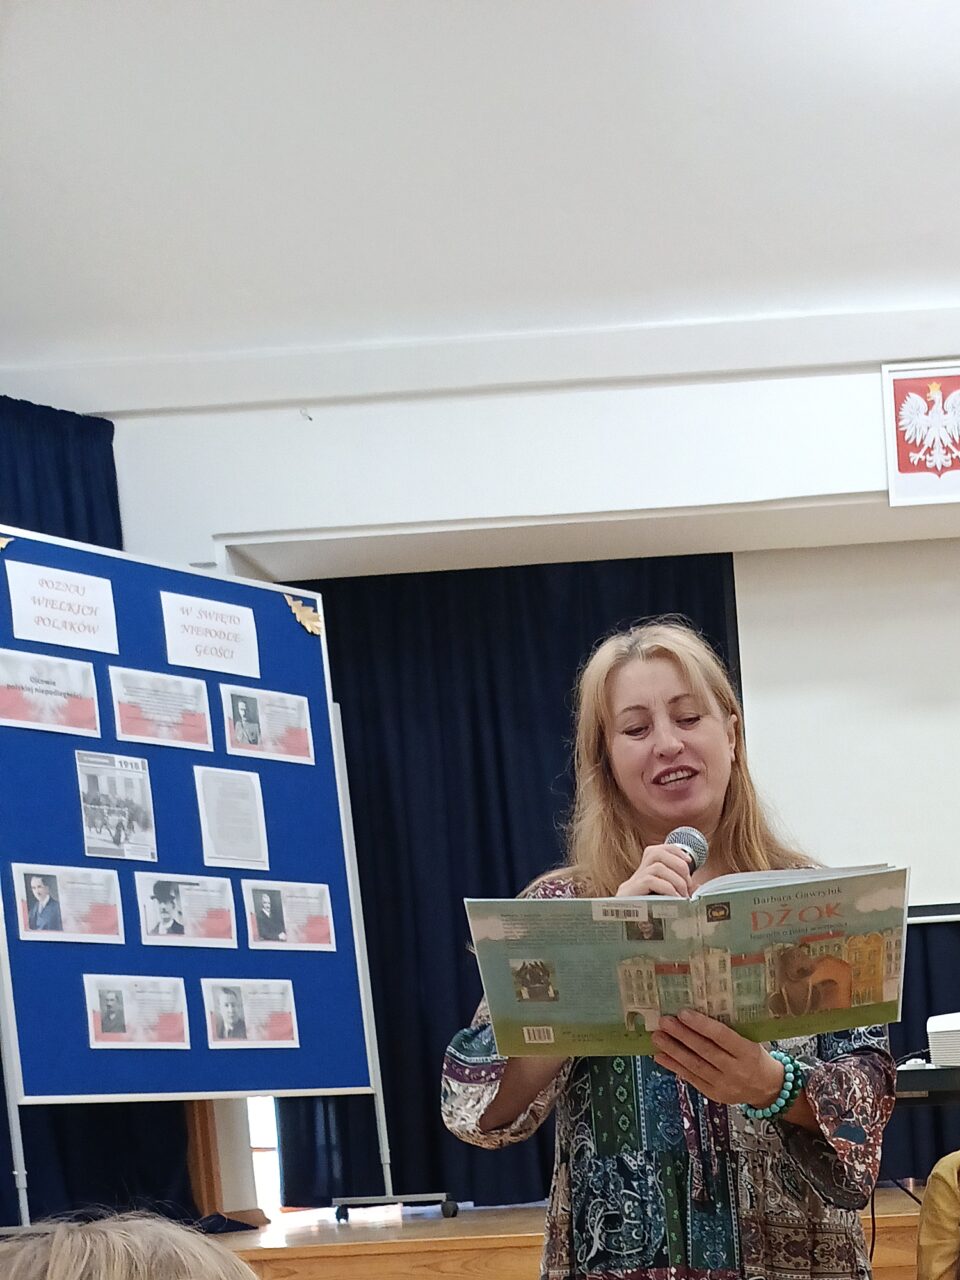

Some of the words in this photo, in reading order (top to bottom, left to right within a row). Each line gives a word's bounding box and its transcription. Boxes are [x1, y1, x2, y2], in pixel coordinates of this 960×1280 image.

[38, 577, 86, 597] POZNAJ
[31, 595, 99, 617] WIELKICH
[180, 606, 192, 617] W
[753, 895, 792, 905] Barbara
[795, 887, 842, 899] Gawryluk
